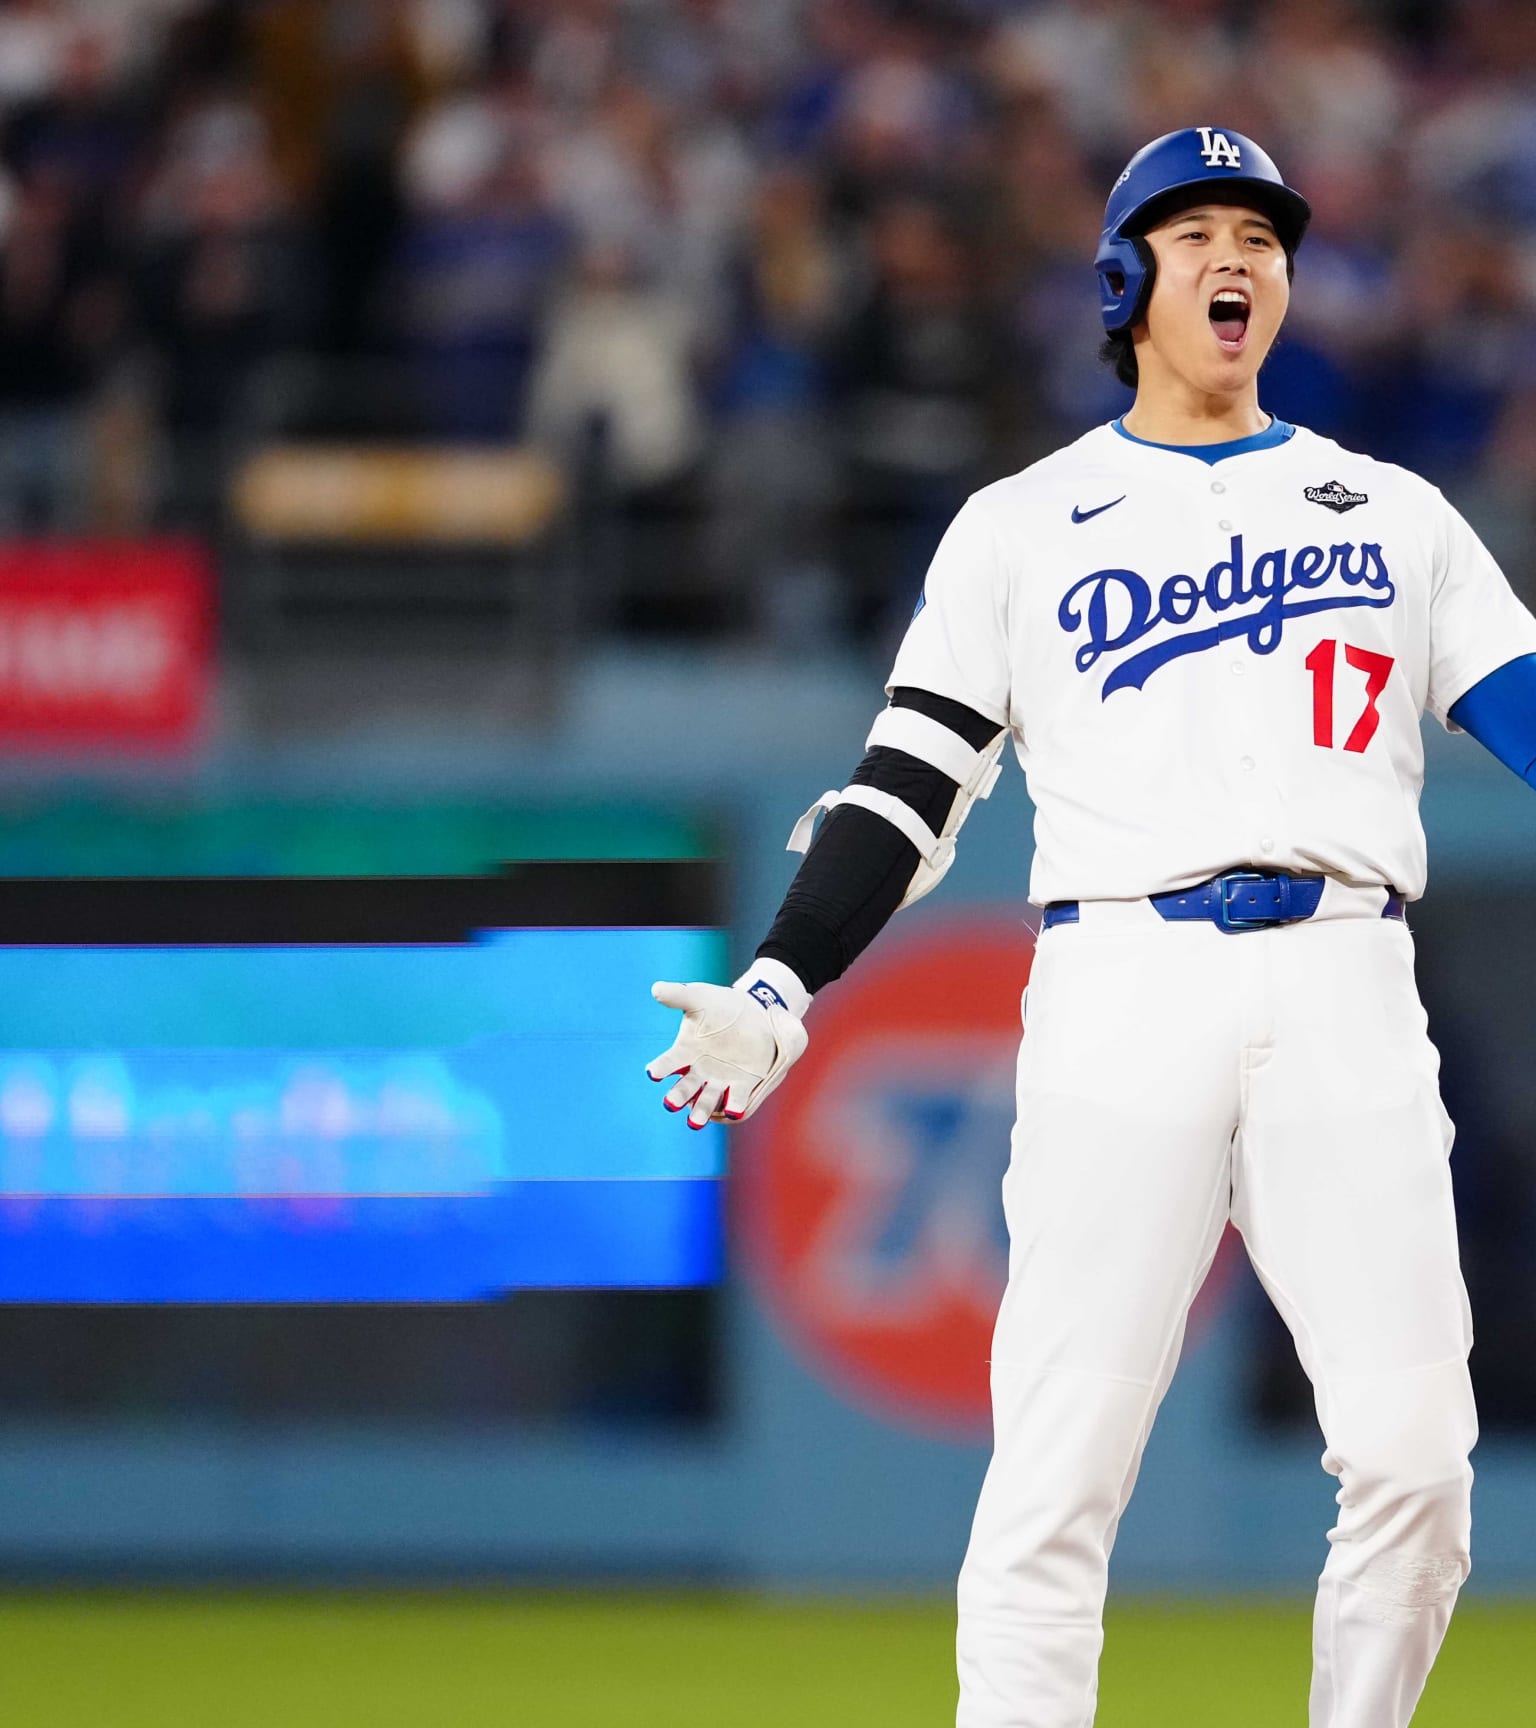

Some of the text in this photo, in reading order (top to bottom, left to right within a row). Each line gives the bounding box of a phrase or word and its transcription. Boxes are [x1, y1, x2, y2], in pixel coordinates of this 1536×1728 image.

[1196, 126, 1241, 168] LA
[1058, 534, 1395, 703] Dodgers
[1305, 639, 1395, 754] 17
